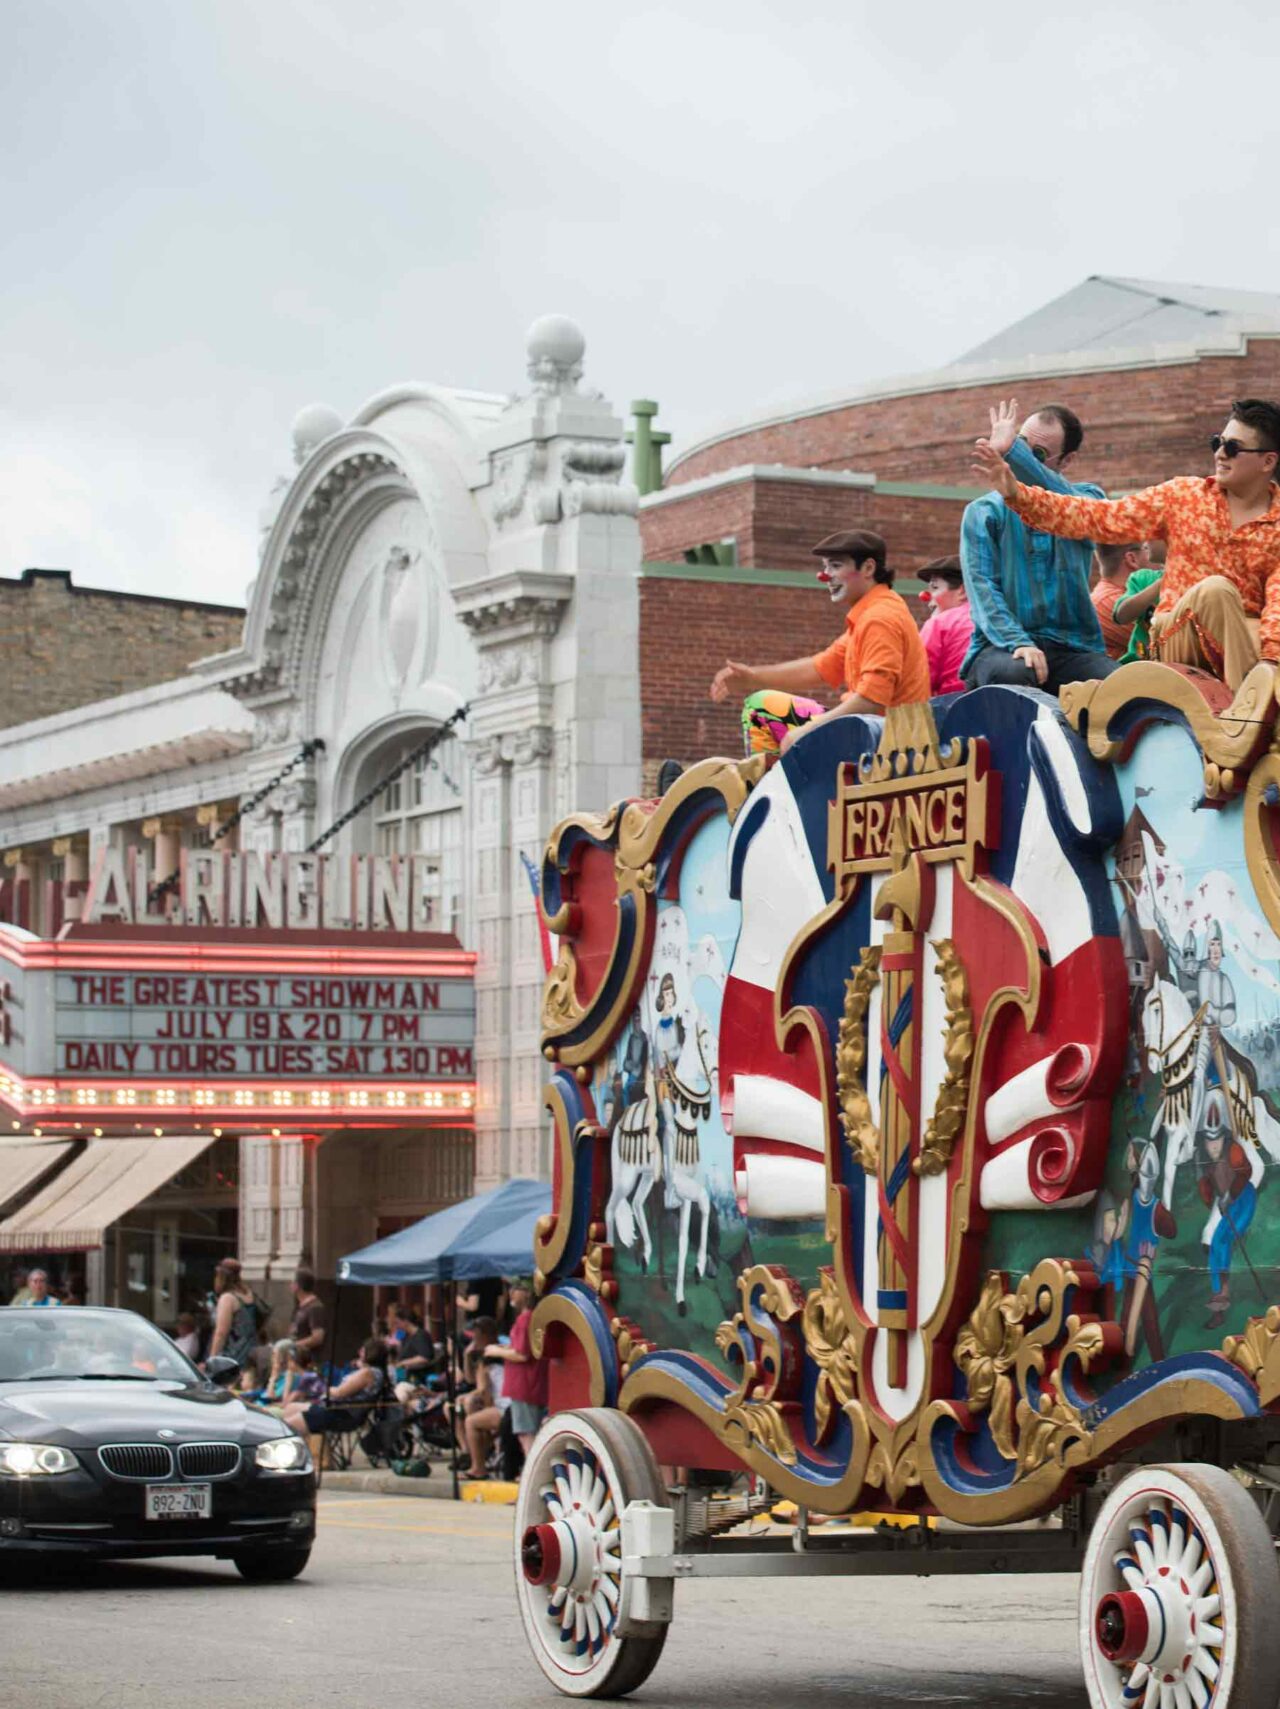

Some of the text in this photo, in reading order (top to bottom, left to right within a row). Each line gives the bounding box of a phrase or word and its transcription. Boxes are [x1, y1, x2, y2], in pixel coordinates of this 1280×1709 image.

[844, 785, 966, 860] FRANCE
[183, 849, 446, 932] RINGLING
[72, 976, 440, 1010] THE GREATEST SHOWMAN
[157, 1010, 233, 1040] JULY
[358, 1014, 374, 1041] 7
[383, 1014, 420, 1041] PM
[64, 1042, 140, 1071] DAILY
[150, 1043, 237, 1073] TOURS
[437, 1046, 473, 1075] PM
[152, 1493, 206, 1512] 892-ZNU
